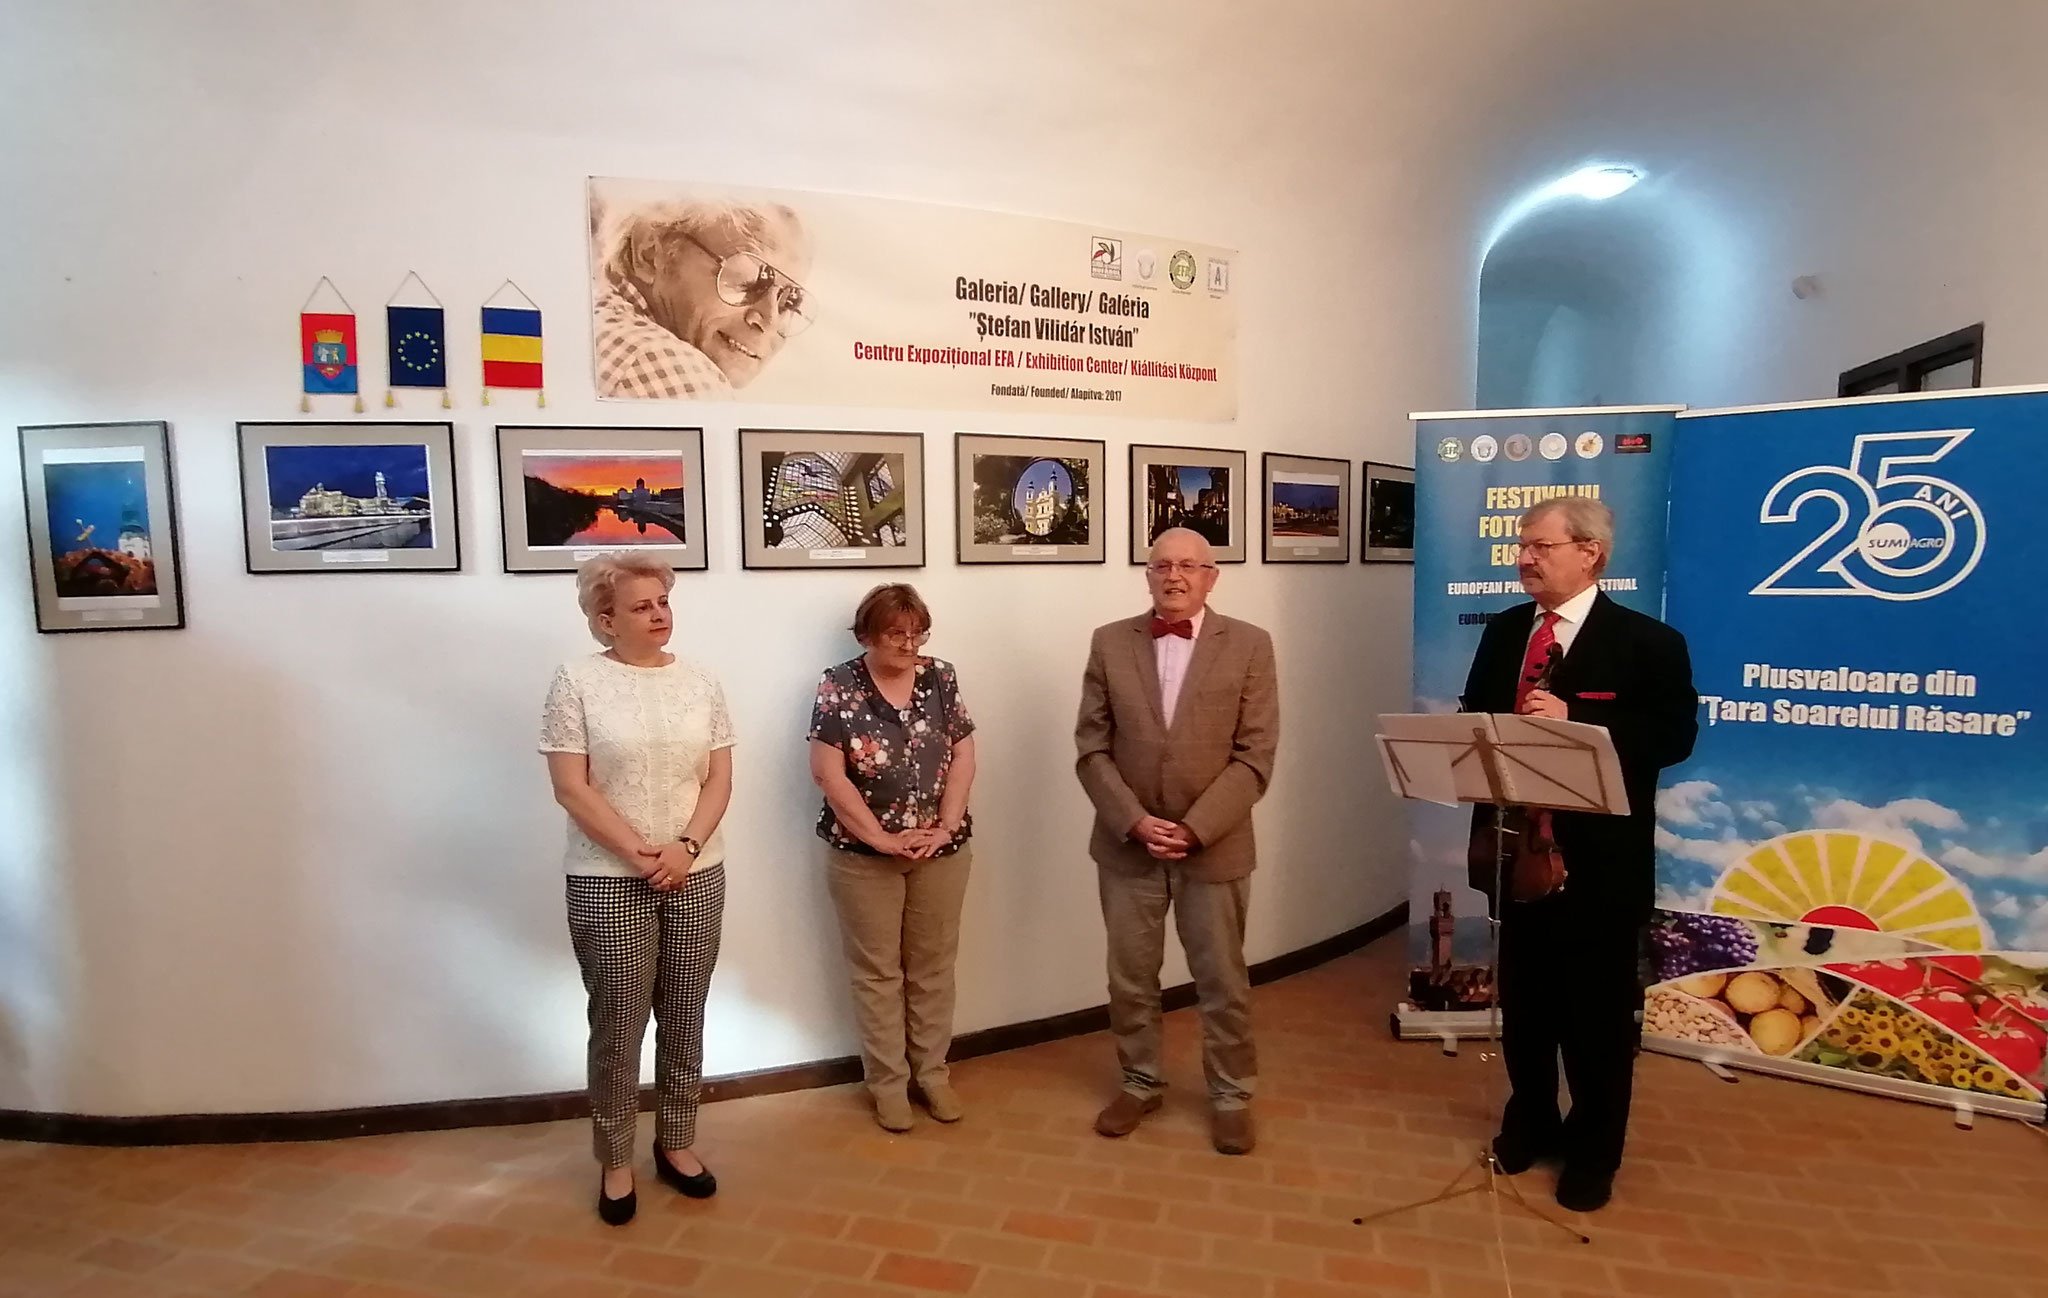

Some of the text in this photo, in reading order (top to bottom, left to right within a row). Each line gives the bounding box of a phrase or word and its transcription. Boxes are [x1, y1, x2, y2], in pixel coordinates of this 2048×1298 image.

[955, 276, 1150, 319] Galeria/ Gallery/ Galéria
[1034, 317, 1086, 344] Vilidár
[854, 341, 904, 362] Centru
[907, 345, 991, 369] Expozițional
[994, 349, 1015, 367] EFA
[1026, 352, 1084, 372] Exhibition
[1086, 356, 1129, 376] Center/
[1131, 360, 1178, 379] Kiállítási
[1179, 364, 1218, 383] Központ
[1031, 386, 1070, 399] Founded/
[1105, 390, 1122, 401] 2017
[1748, 428, 1987, 602] 25
[1913, 484, 1969, 520] ANI
[1447, 582, 1503, 595] EUROPEAN
[1598, 578, 1639, 592] STIVAL
[1742, 663, 1977, 697] Plusvaloare din
[1773, 699, 1899, 730] Soarelui
